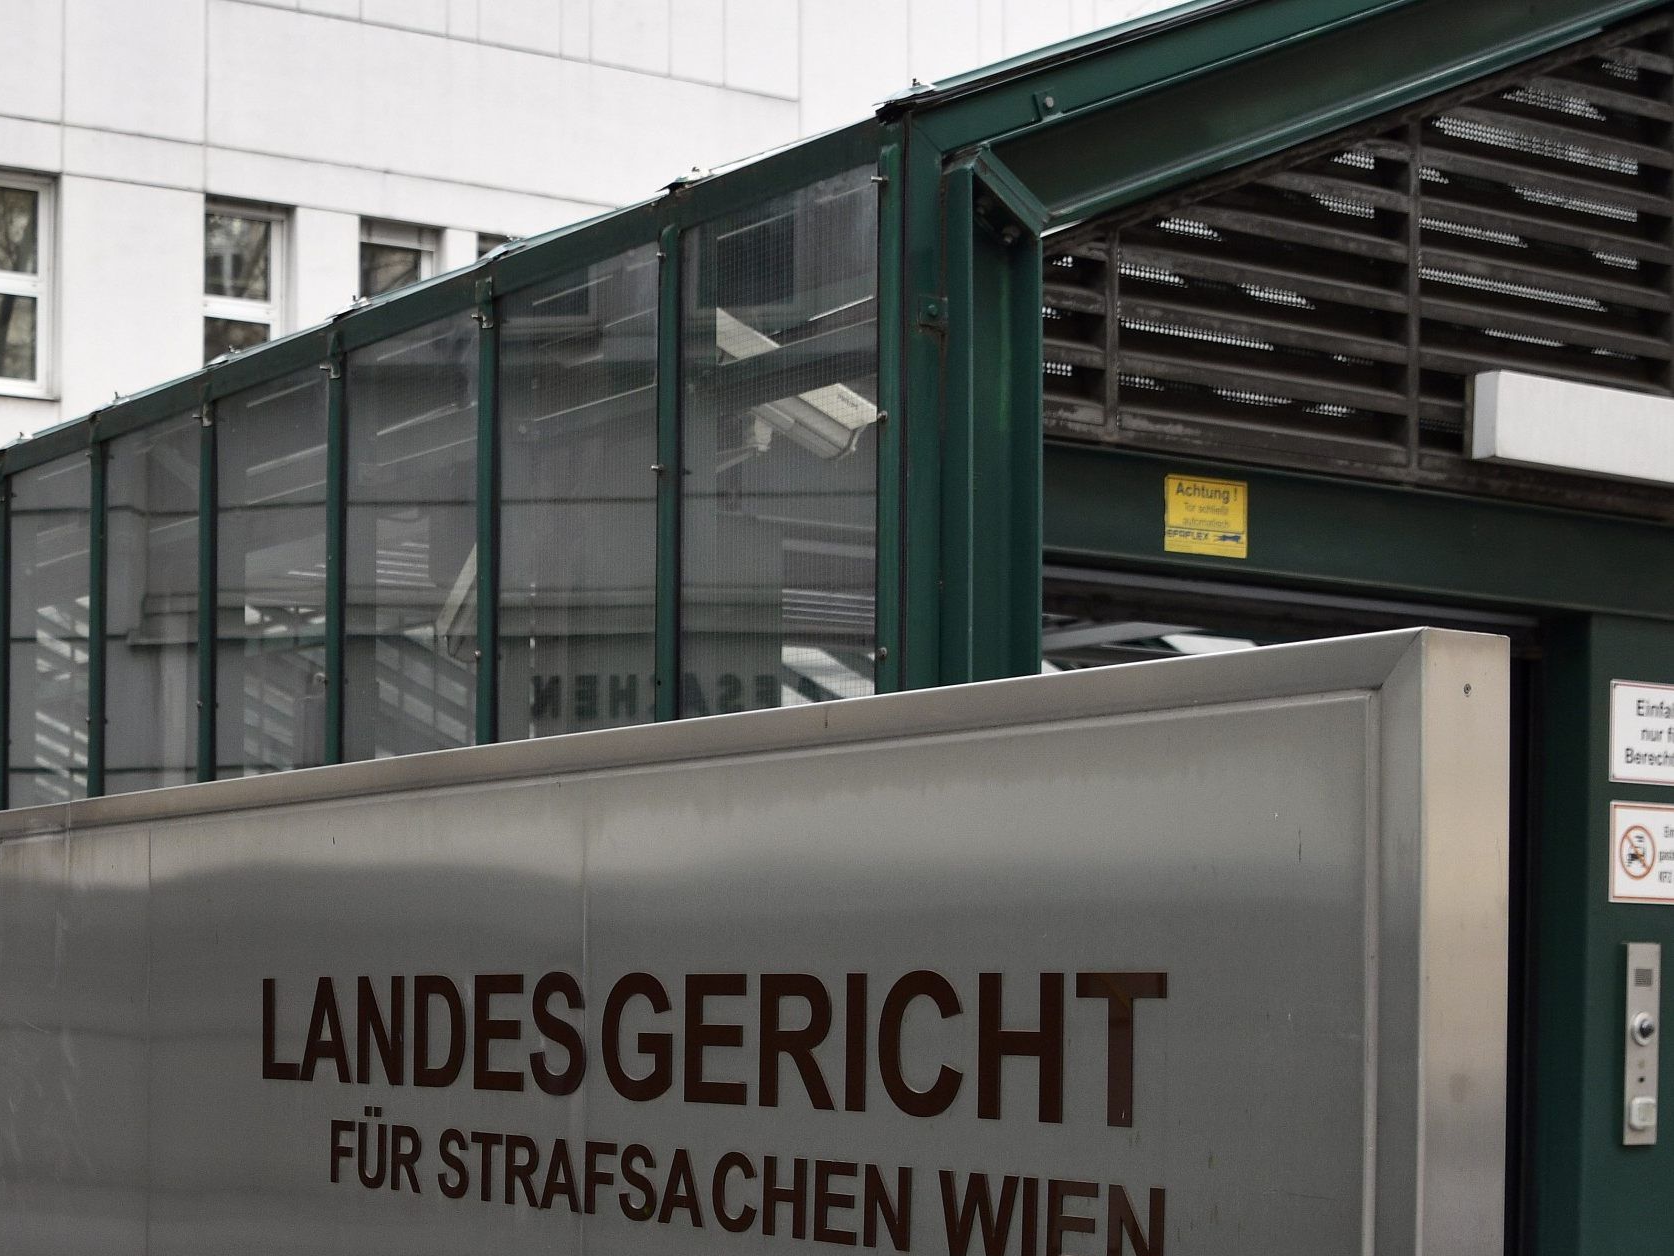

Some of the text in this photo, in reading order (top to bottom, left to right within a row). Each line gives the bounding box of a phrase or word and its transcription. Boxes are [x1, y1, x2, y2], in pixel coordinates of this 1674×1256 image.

[1176, 482, 1231, 504] Achtung
[262, 970, 1167, 1128] LANDESGERICHT
[330, 1105, 422, 1194] FÜR
[438, 1128, 912, 1252] STRAFSACHEN
